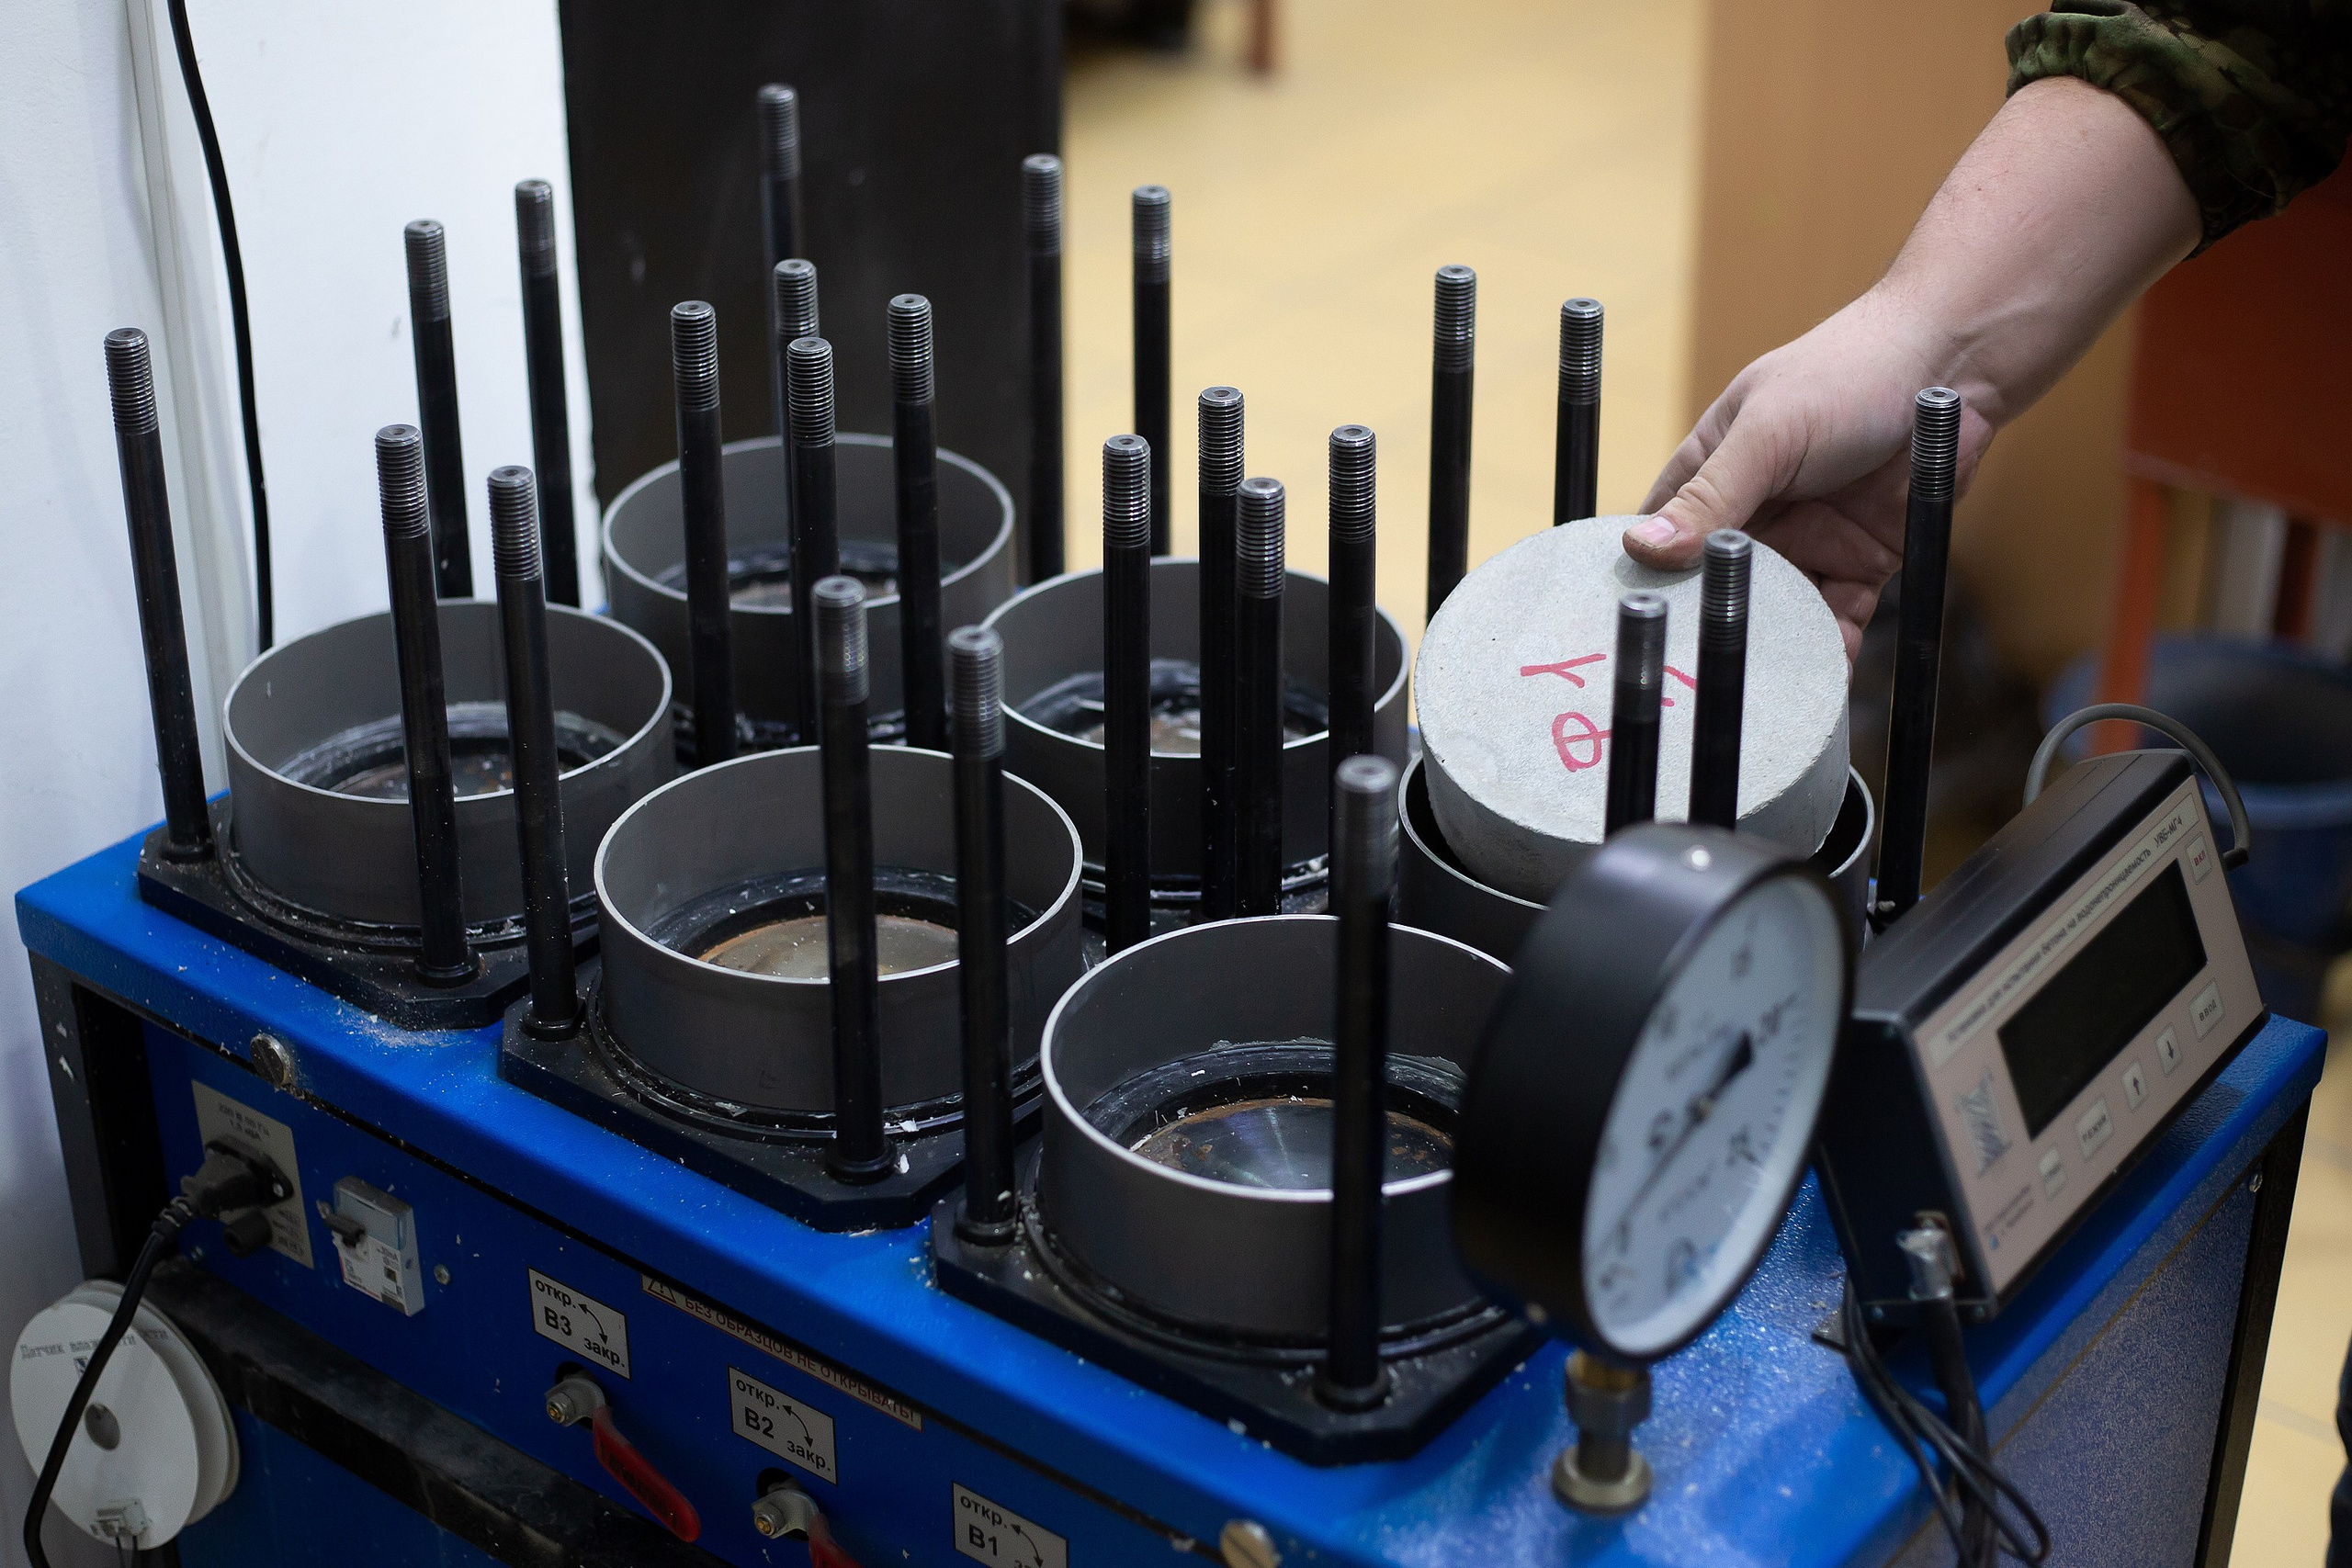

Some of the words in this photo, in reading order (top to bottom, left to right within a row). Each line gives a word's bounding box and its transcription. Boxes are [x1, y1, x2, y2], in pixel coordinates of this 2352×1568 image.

[2075, 848, 2152, 919] водонепроницаемость
[2154, 816, 2183, 848] УВБ-МГ4
[2193, 850, 2207, 867] ВКЛ
[2199, 998, 2218, 1021] ВВОД
[535, 1279, 577, 1309] откр.
[544, 1306, 572, 1337] В3
[684, 1297, 712, 1320] БЕЗ
[716, 1314, 793, 1360] ОБРАЗЦОВ
[797, 1350, 816, 1371] НЕ
[19, 1343, 65, 1360] Датчик
[583, 1337, 626, 1368] закр.
[736, 1379, 781, 1410] откр.
[744, 1406, 775, 1439] В2
[786, 1440, 831, 1472] закр.
[960, 1495, 1008, 1529] откр.
[968, 1523, 998, 1556] В1
